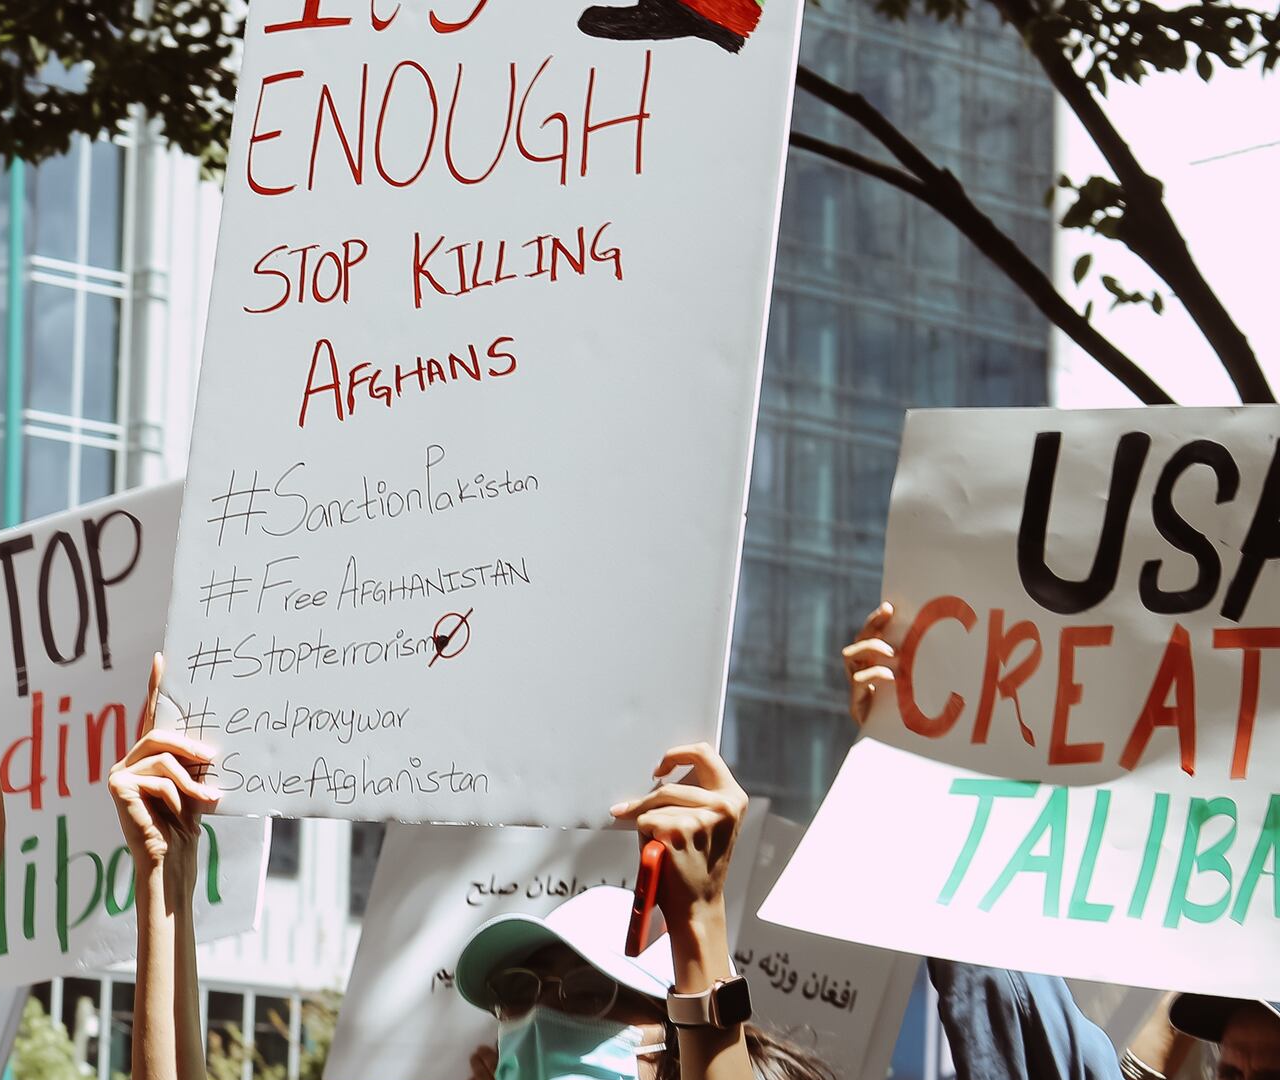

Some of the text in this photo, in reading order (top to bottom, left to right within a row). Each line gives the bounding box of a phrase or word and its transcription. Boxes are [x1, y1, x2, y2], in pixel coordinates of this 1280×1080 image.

[246, 49, 651, 196] ENOUGH
[243, 221, 625, 313] STOP KILLING
[299, 335, 518, 427] AFGHANS
[894, 594, 1280, 778] CREAT
